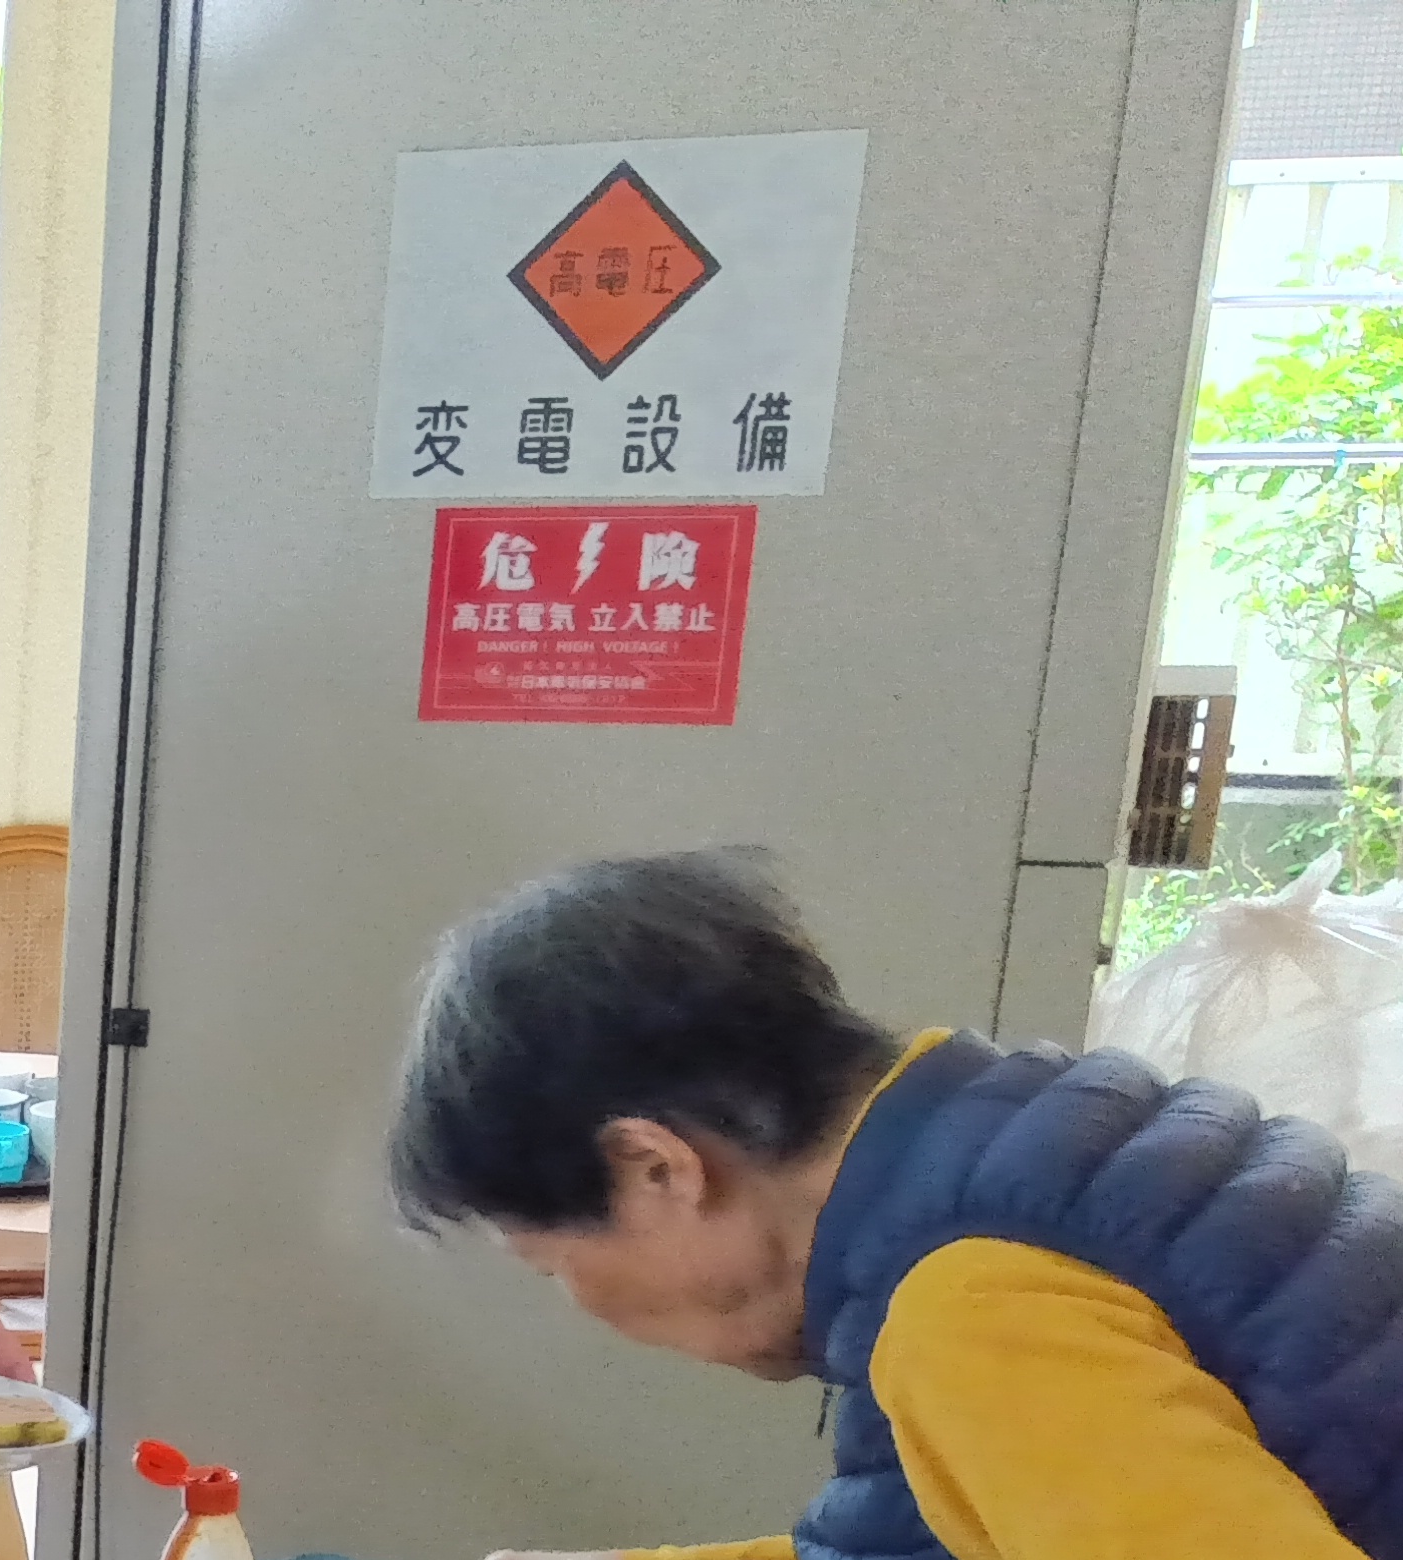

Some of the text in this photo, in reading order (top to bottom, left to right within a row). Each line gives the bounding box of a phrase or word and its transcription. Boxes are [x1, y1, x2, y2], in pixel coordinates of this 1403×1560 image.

[549, 244, 679, 298] 高電圧
[411, 391, 793, 477] 変電設備
[451, 602, 717, 633] 高圧電気 立入禁止
